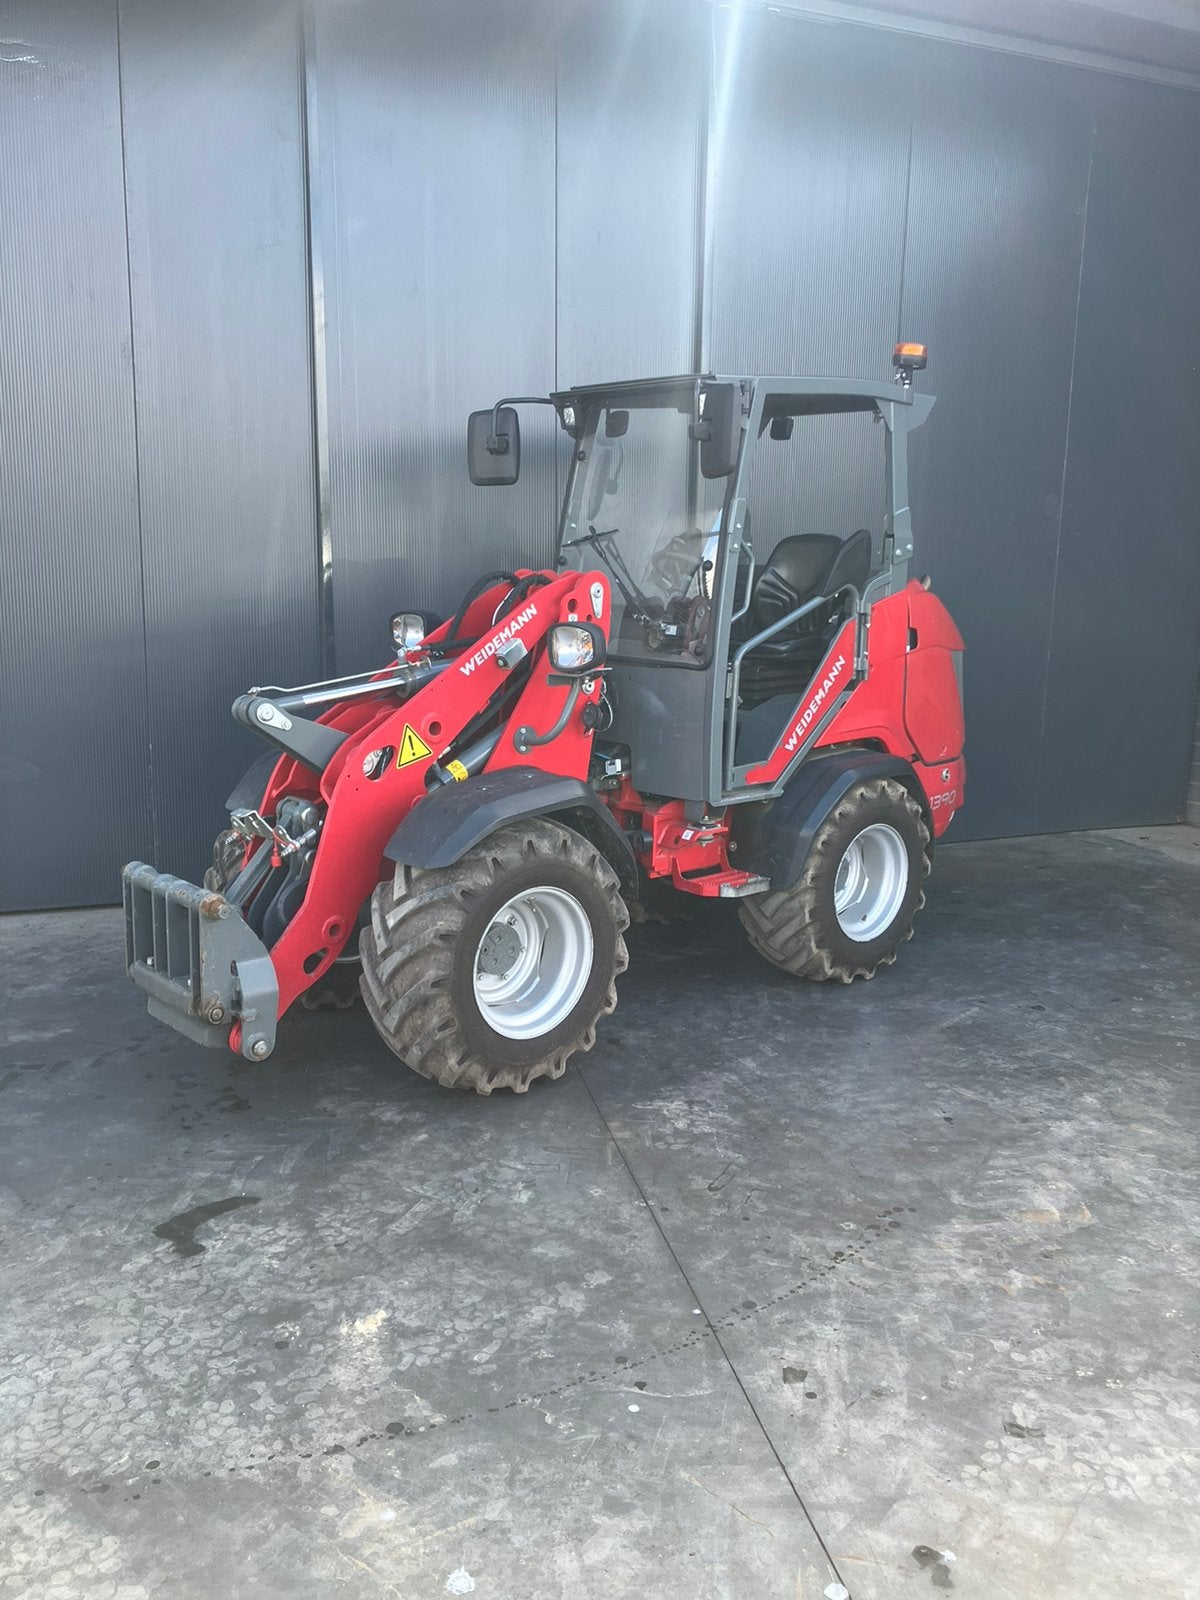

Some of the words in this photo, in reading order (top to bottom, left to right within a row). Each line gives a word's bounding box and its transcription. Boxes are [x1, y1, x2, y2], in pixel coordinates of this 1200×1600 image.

[459, 603, 538, 676] WEIDEMANN
[784, 654, 846, 751] WEIDEMANN
[930, 789, 957, 810] 1390
